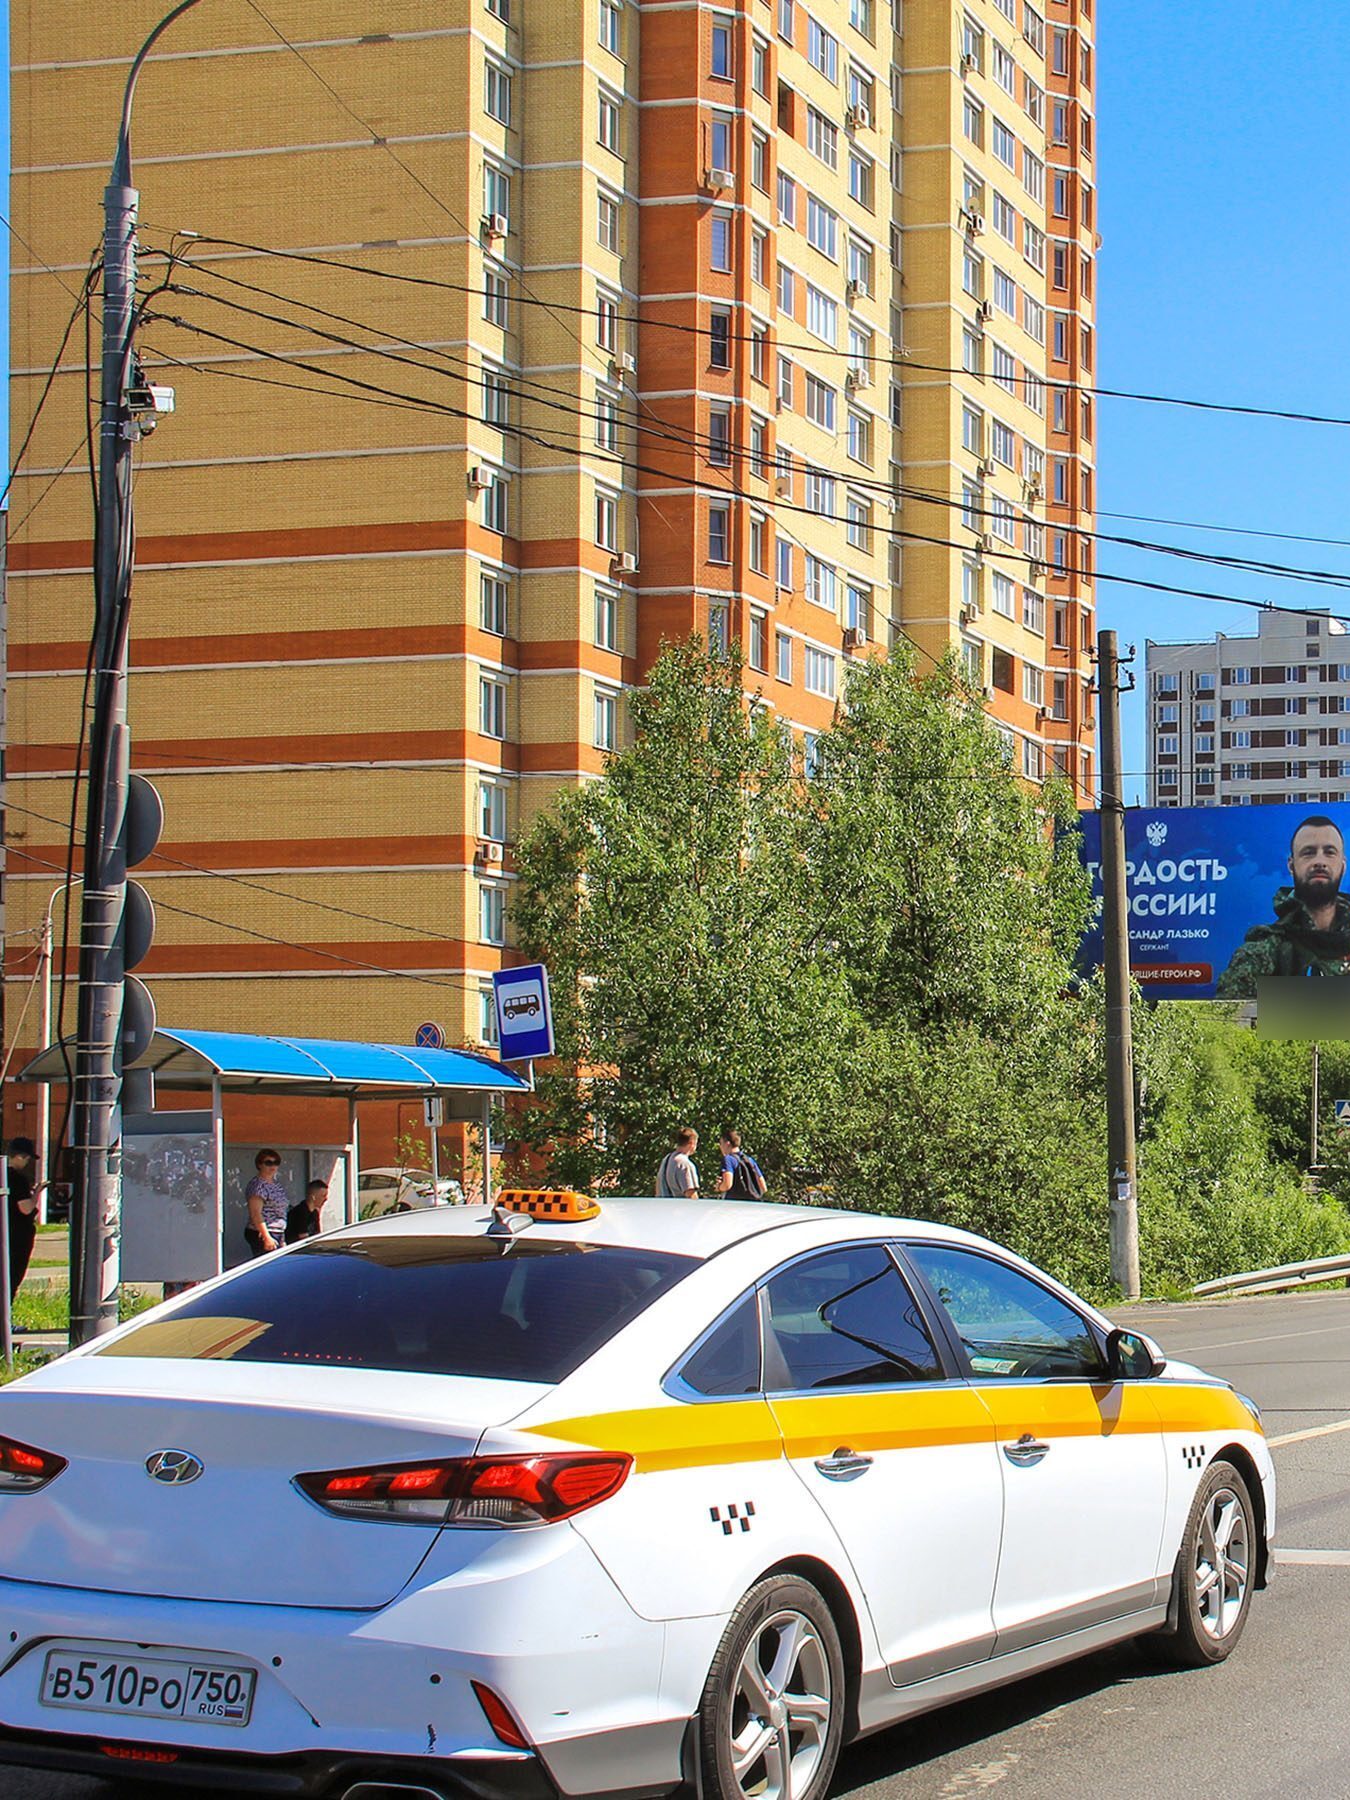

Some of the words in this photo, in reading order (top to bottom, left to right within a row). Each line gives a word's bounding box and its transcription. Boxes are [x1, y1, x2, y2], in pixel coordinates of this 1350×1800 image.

[1087, 859, 1228, 886] ГРДОСТЬ
[1095, 893, 1217, 917] ССИИ!
[1166, 928, 1209, 939] ЛАЗЬКО
[1129, 969, 1202, 980] ОЯЩИЕ-ГЕРОИ.РФ
[190, 1670, 242, 1703] 750
[198, 1703, 224, 1716] RUS
